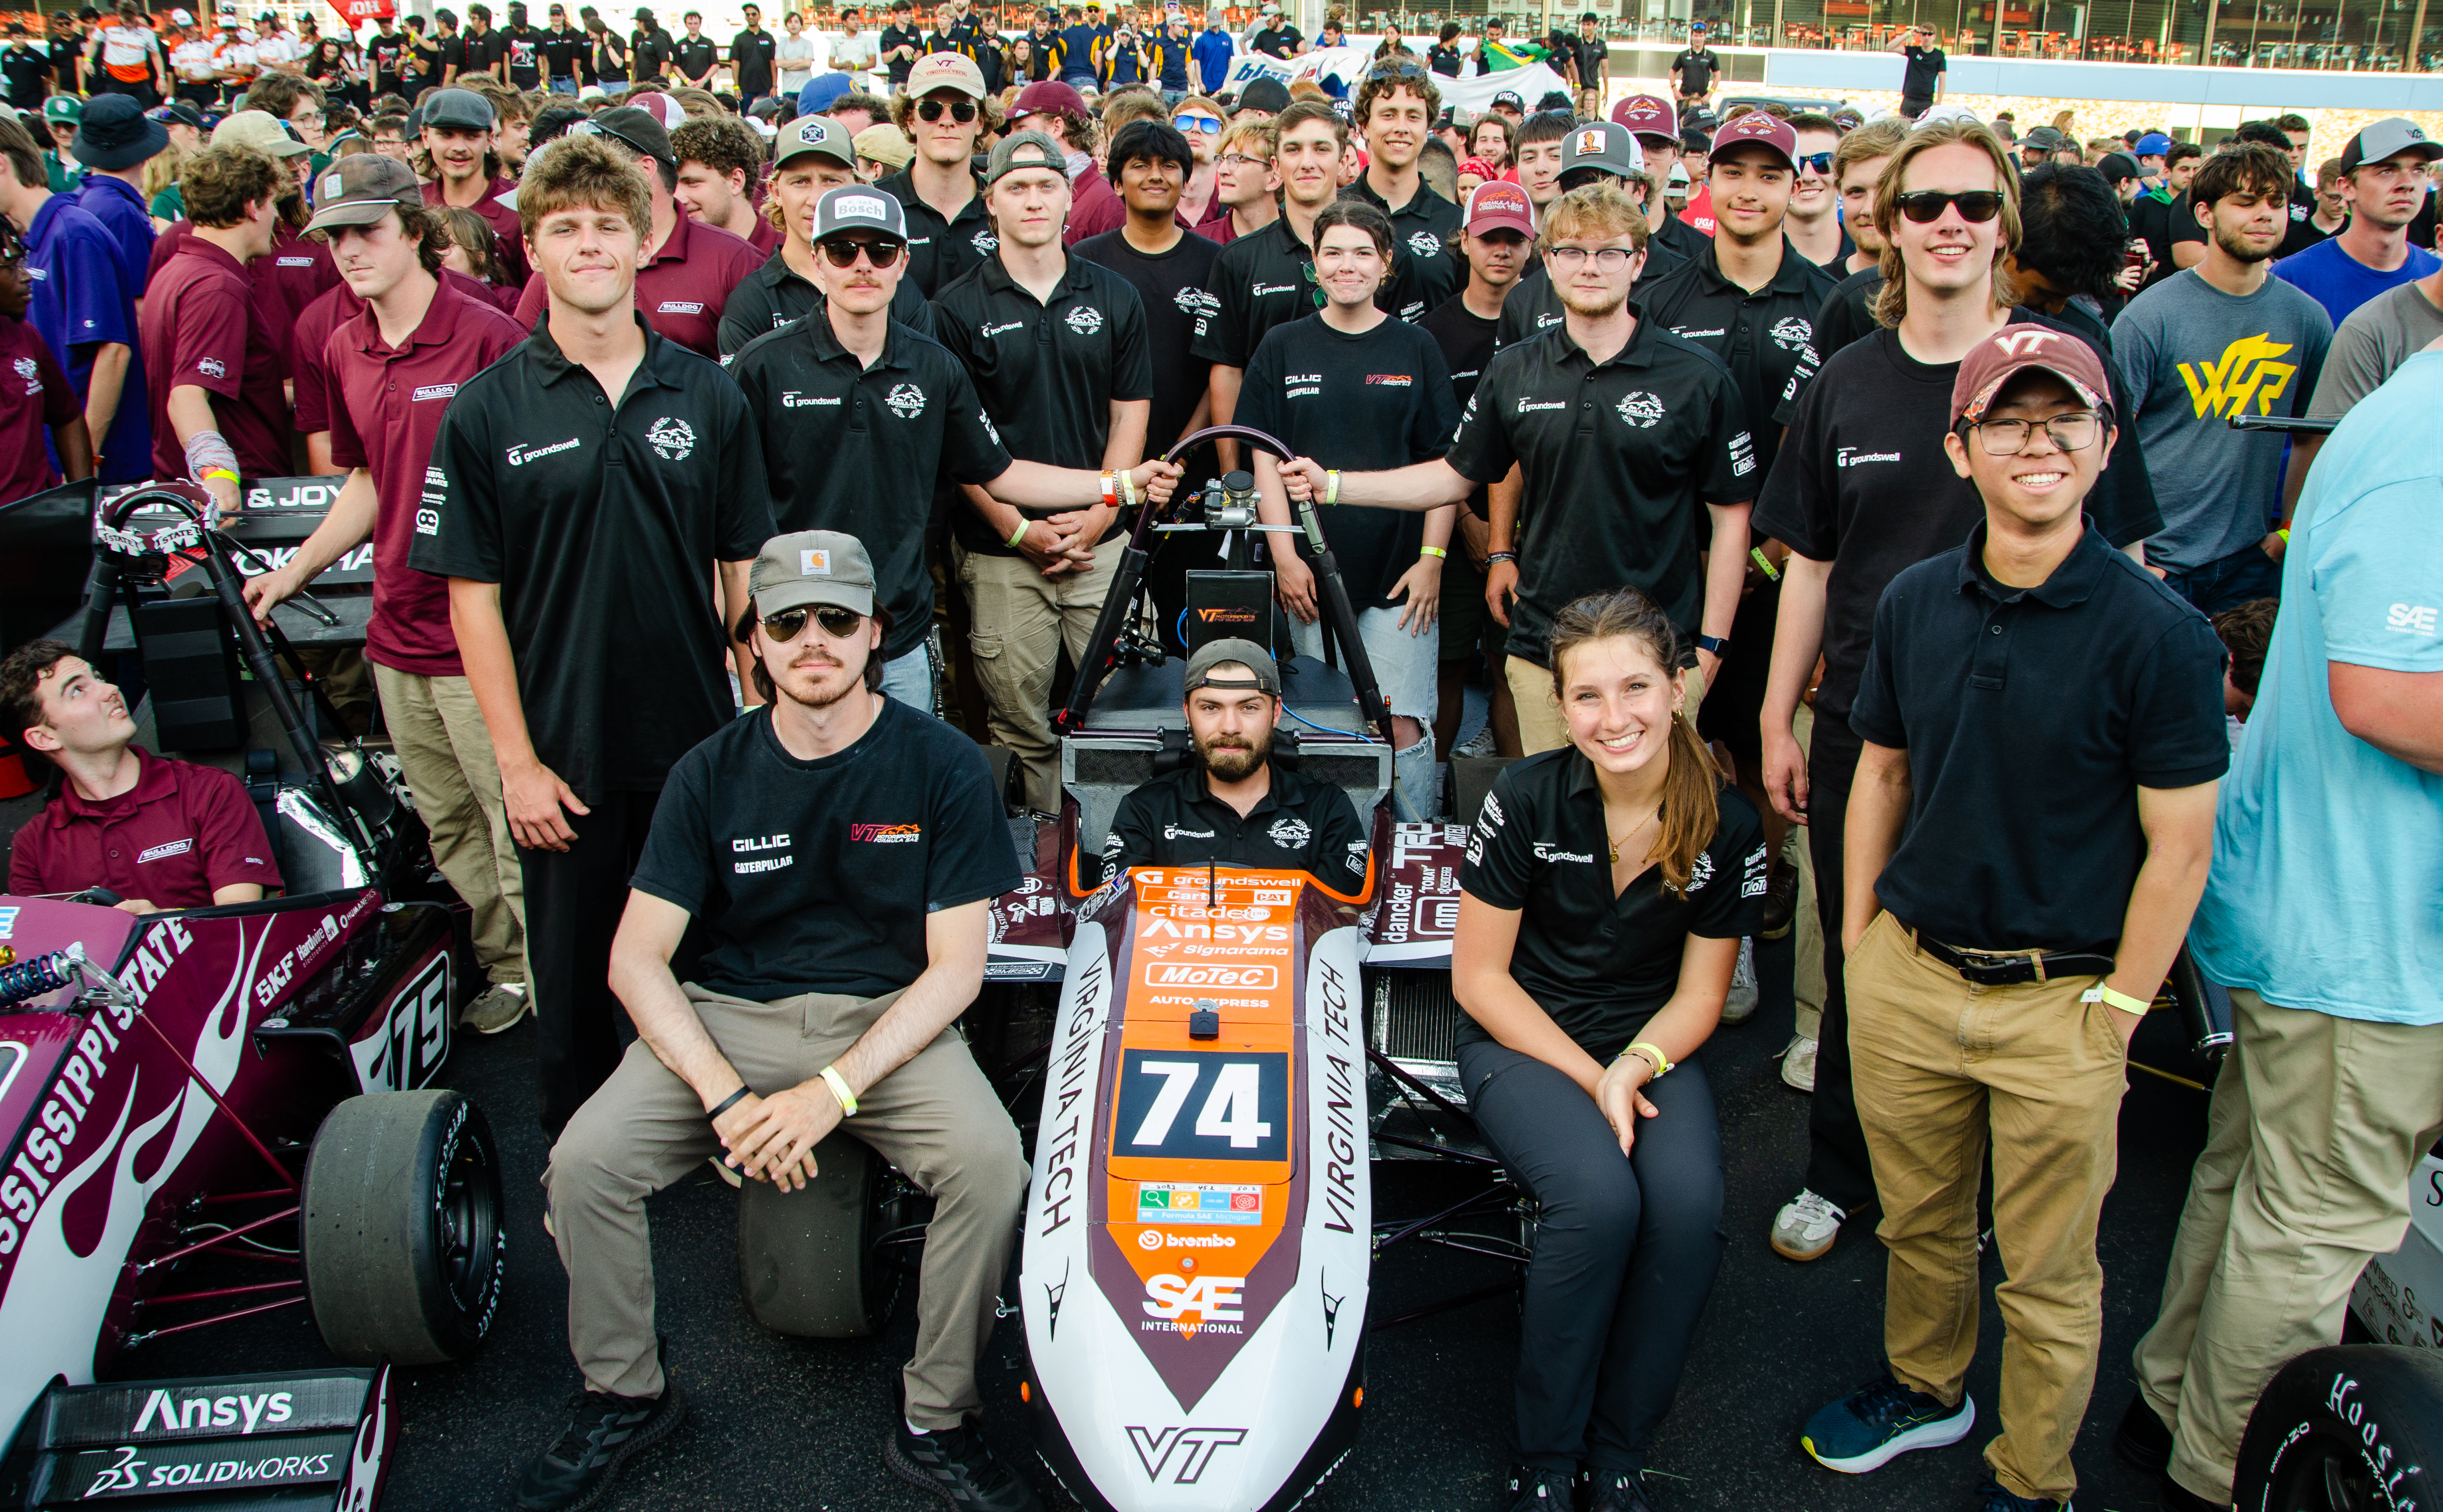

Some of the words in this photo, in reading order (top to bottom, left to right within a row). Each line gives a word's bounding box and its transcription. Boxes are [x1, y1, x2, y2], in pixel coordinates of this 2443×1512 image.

[326, 177, 339, 190] 62
[839, 205, 881, 217] Bosch
[1694, 217, 1715, 228] UGA
[907, 236, 931, 245] ndswell
[1267, 285, 1296, 295] groundswell
[990, 321, 1023, 336] groundswell
[1682, 328, 1724, 339] groundswell
[1993, 331, 2061, 359] VT
[1285, 374, 1322, 385] GILLIG
[1451, 370, 1478, 380] oundswell
[417, 386, 454, 396] BULLDOG
[1286, 387, 1320, 399] CATERPILLAR
[796, 398, 841, 406] groundswell
[1525, 401, 1566, 412] groundswell
[649, 437, 680, 446] FORMULA
[524, 438, 580, 462] groundswell
[1849, 452, 1900, 466] groundswell
[248, 488, 276, 508] &
[109, 535, 134, 547] STATE
[163, 529, 193, 544] STATE
[1197, 609, 1224, 622] VT
[2386, 603, 2439, 631] SAE
[851, 823, 883, 842] VT
[1174, 829, 1215, 838] roundswell
[143, 842, 187, 857] BULLDOG
[733, 833, 791, 852] GILLIG
[734, 855, 793, 873] CATERPILLAR
[1173, 875, 1301, 887] groundswell
[1694, 871, 1711, 880] SAE
[1167, 890, 1227, 901] Carter
[1257, 893, 1287, 902] CAT
[346, 888, 377, 921] HUMANETICS
[1382, 881, 1413, 943] dancker
[1140, 919, 1288, 944] Ansys
[296, 927, 326, 961] Hardwire
[1183, 944, 1289, 956] Signarama
[302, 939, 329, 969] electronics
[254, 950, 295, 1008] SKF
[1159, 966, 1264, 985] MoTeC
[1149, 995, 1194, 1005] AUTO
[1319, 957, 1350, 1047] TECH
[395, 969, 444, 1091] 75
[1055, 950, 1106, 1121] VIRGINIA
[1131, 1060, 1271, 1149] 74
[1324, 1052, 1355, 1235] VIRGINIA
[1041, 1114, 1080, 1238] TECH
[1166, 1233, 1236, 1247] brembo
[1142, 1273, 1245, 1322] SAE
[1141, 1321, 1243, 1335] INTERNATIONAL
[132, 1389, 293, 1434] Ansys
[2325, 1372, 2423, 1512] Hoosie
[1124, 1425, 1250, 1484] VT
[147, 1454, 334, 1487] SOLIDWORKS
